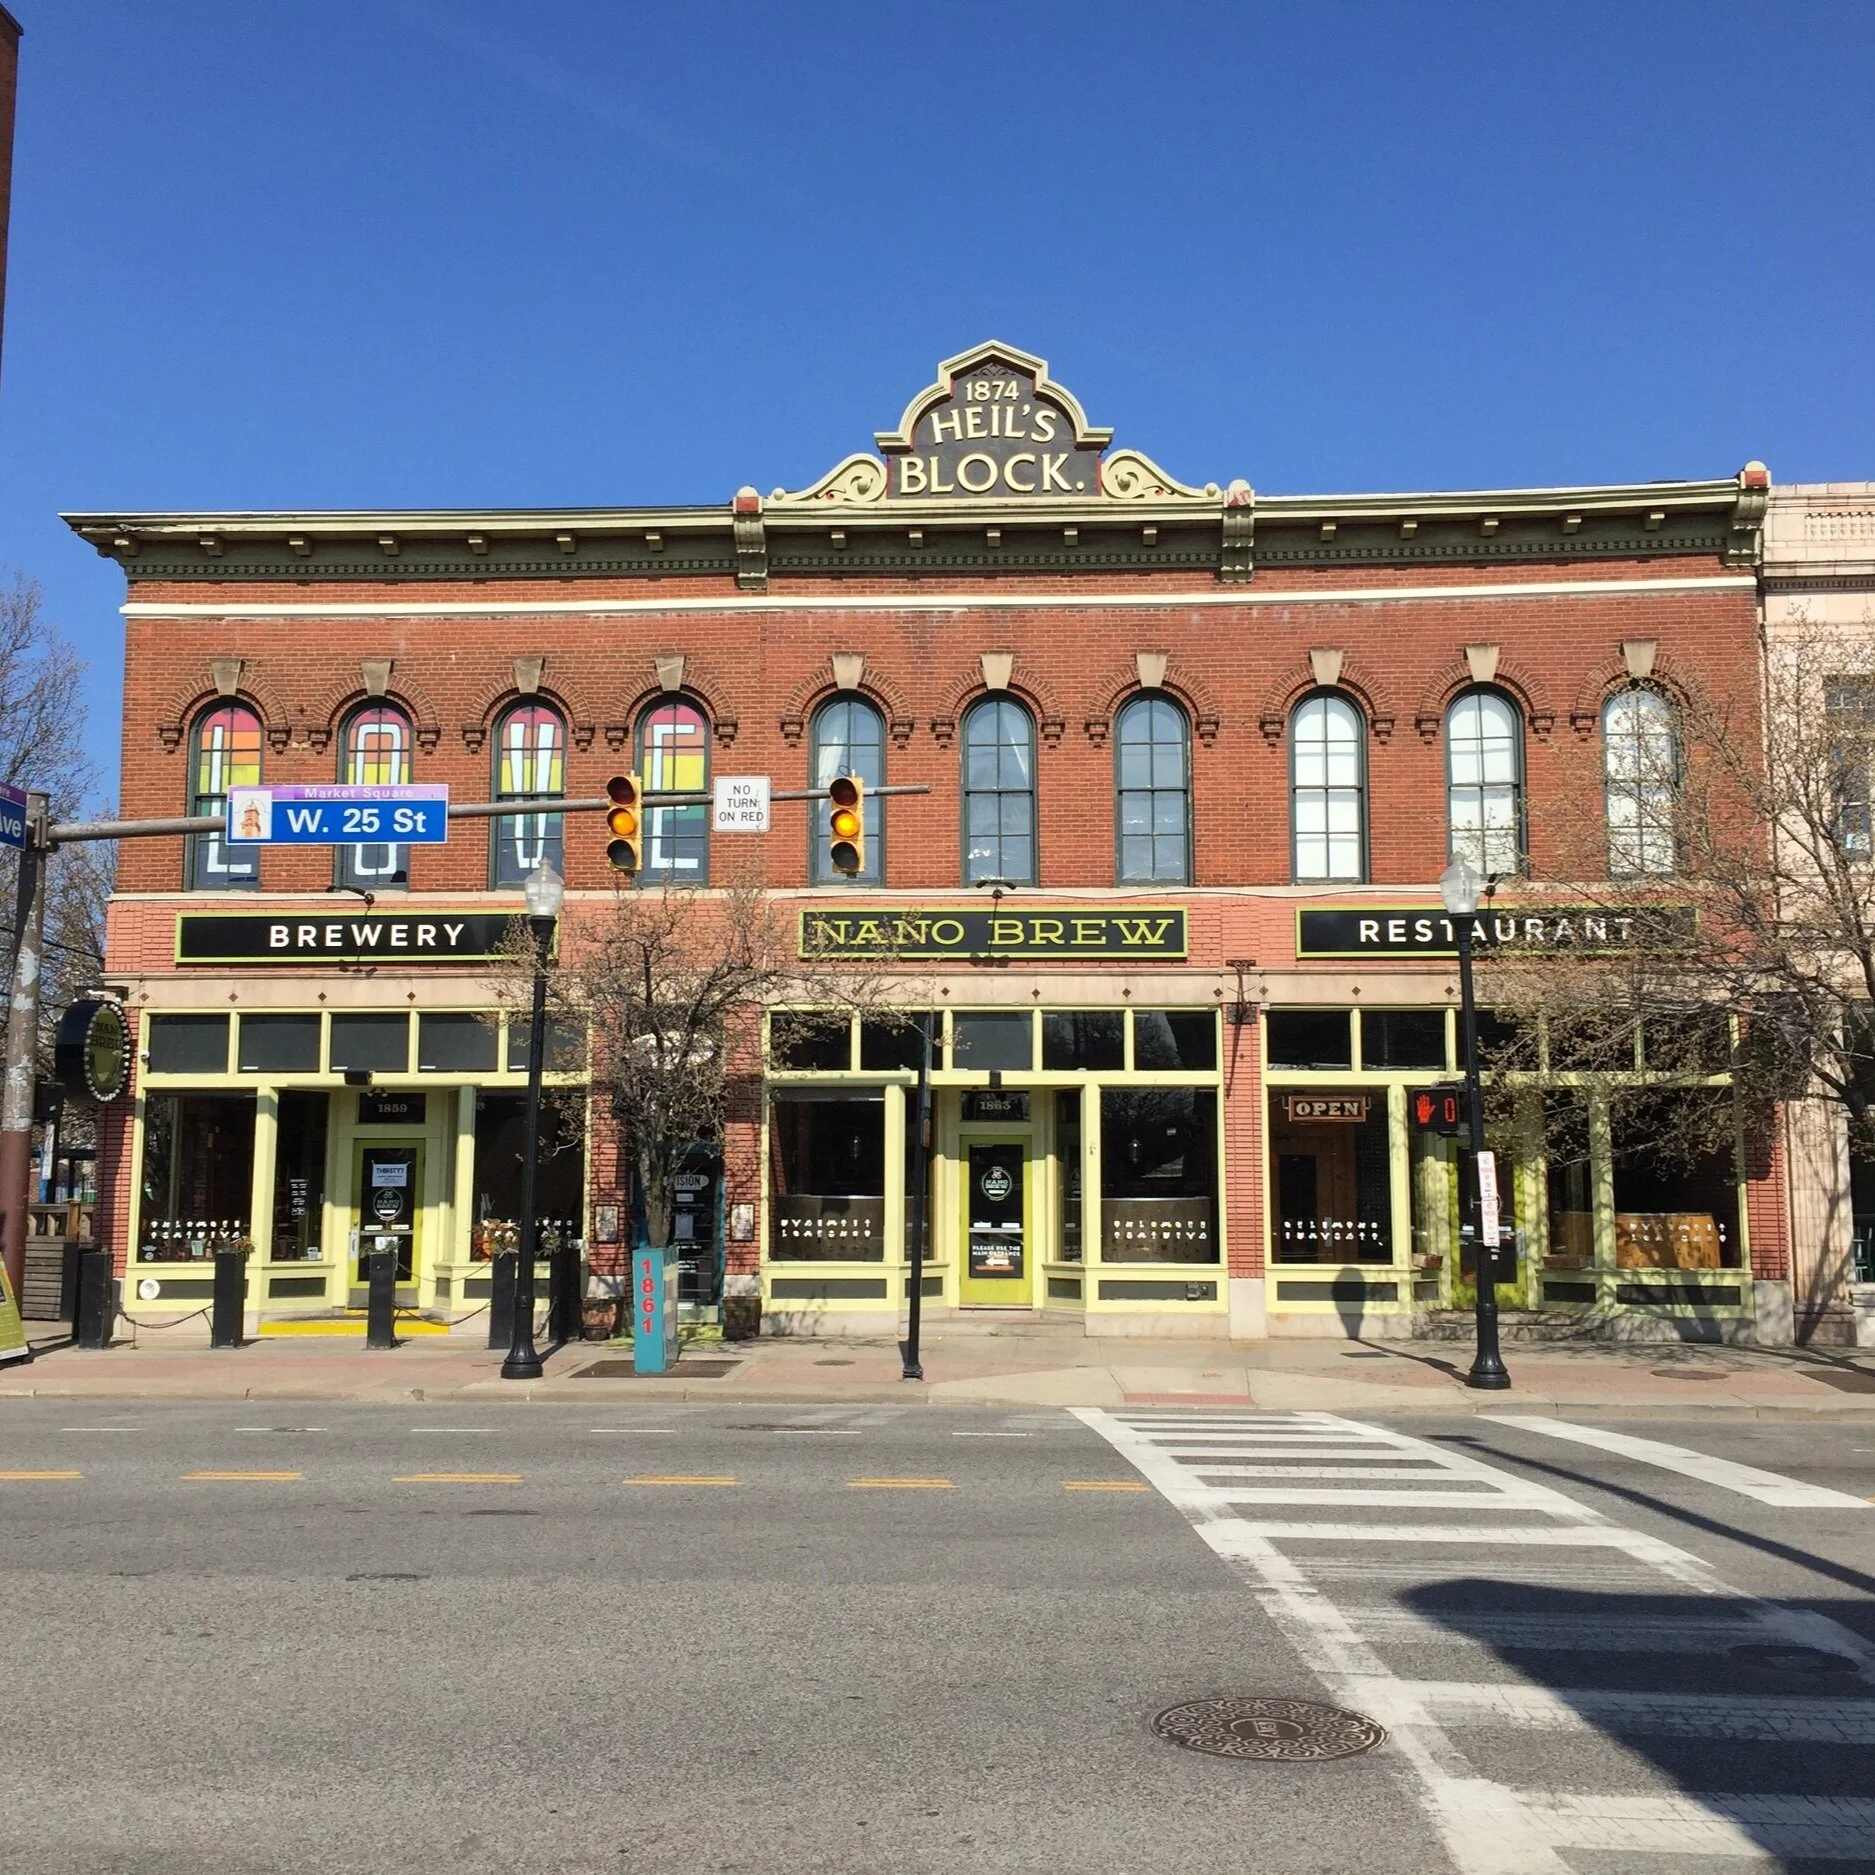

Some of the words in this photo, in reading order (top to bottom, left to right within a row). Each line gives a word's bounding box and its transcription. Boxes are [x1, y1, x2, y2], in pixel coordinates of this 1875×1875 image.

[965, 380, 1019, 402] 1874
[930, 404, 1057, 444] HEIL'S
[899, 452, 1085, 494] BLOCK.
[304, 787, 356, 799] Market
[362, 787, 414, 801] Square
[733, 784, 751, 796] NO
[727, 798, 757, 809] TURN
[286, 808, 329, 833] W.
[342, 808, 380, 833] 25
[393, 808, 427, 833] St
[718, 811, 735, 822] ON
[740, 811, 764, 822] RED
[269, 923, 465, 948] BREWERY
[811, 919, 965, 945] NANO
[988, 919, 1174, 945] BREW
[1359, 918, 1633, 943] RESTAURANT
[377, 1103, 408, 1113] 1859
[1296, 1102, 1359, 1116] OPEN
[671, 1175, 701, 1187] ISION
[641, 1258, 655, 1334] 1861
